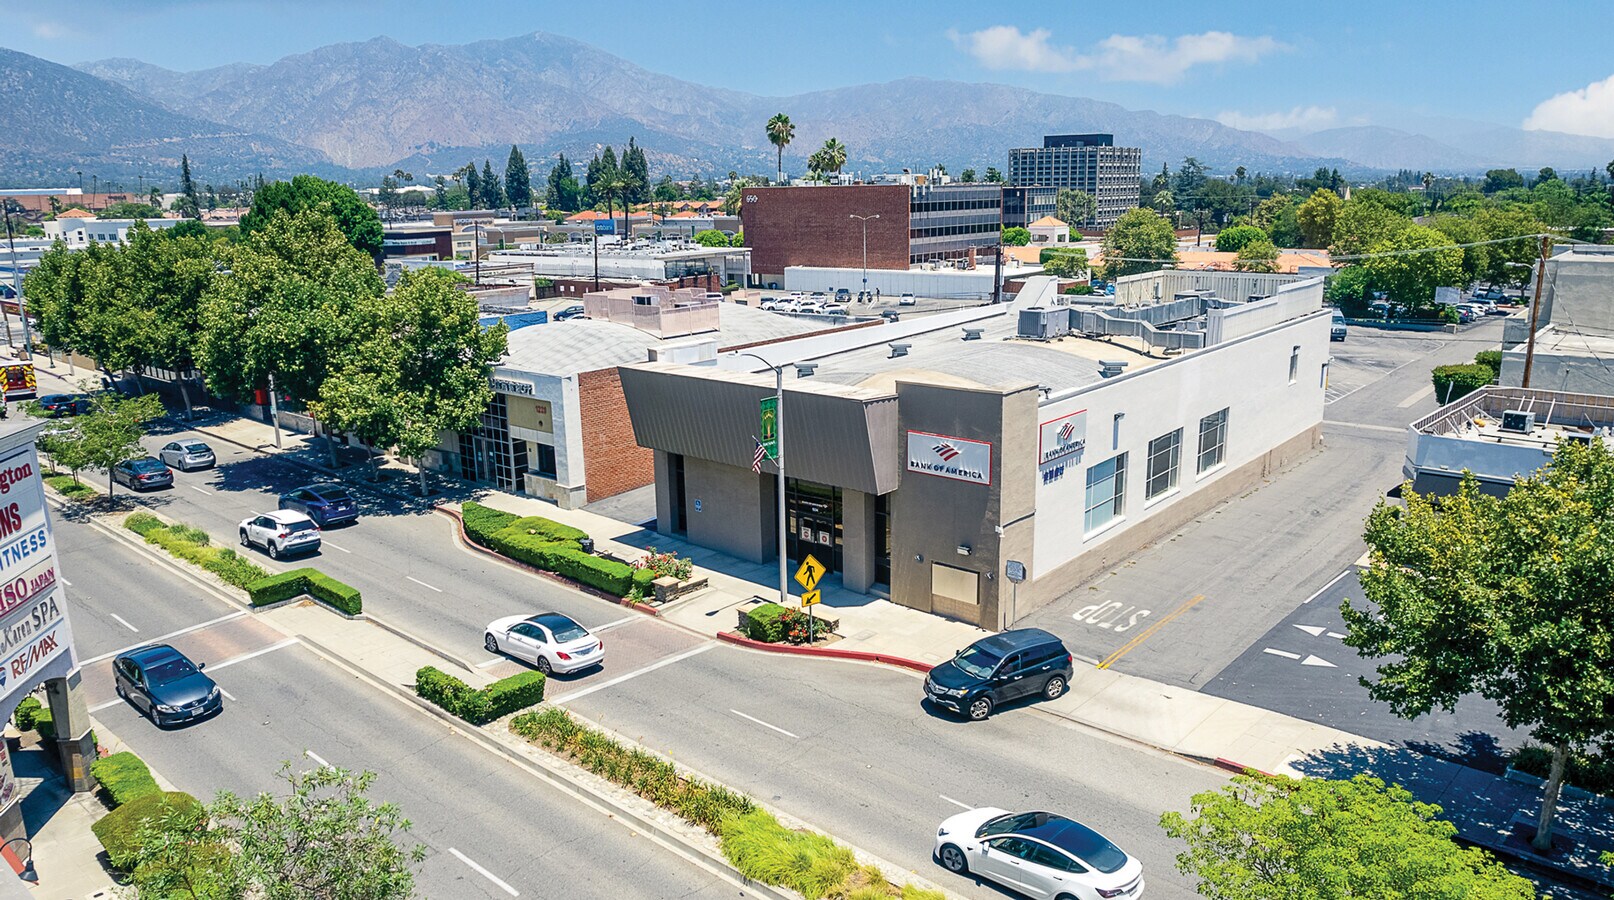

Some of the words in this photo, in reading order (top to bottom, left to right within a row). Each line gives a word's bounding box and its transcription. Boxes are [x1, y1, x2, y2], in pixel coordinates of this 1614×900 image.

[910, 460, 931, 471] BANK
[934, 464, 945, 472] OF
[945, 466, 983, 480] AMERICA
[0, 502, 22, 540] NS
[30, 566, 56, 592] JAPAN
[31, 596, 60, 631] SPA
[1072, 600, 1152, 632] STOP
[11, 630, 59, 679] RE/MAX
